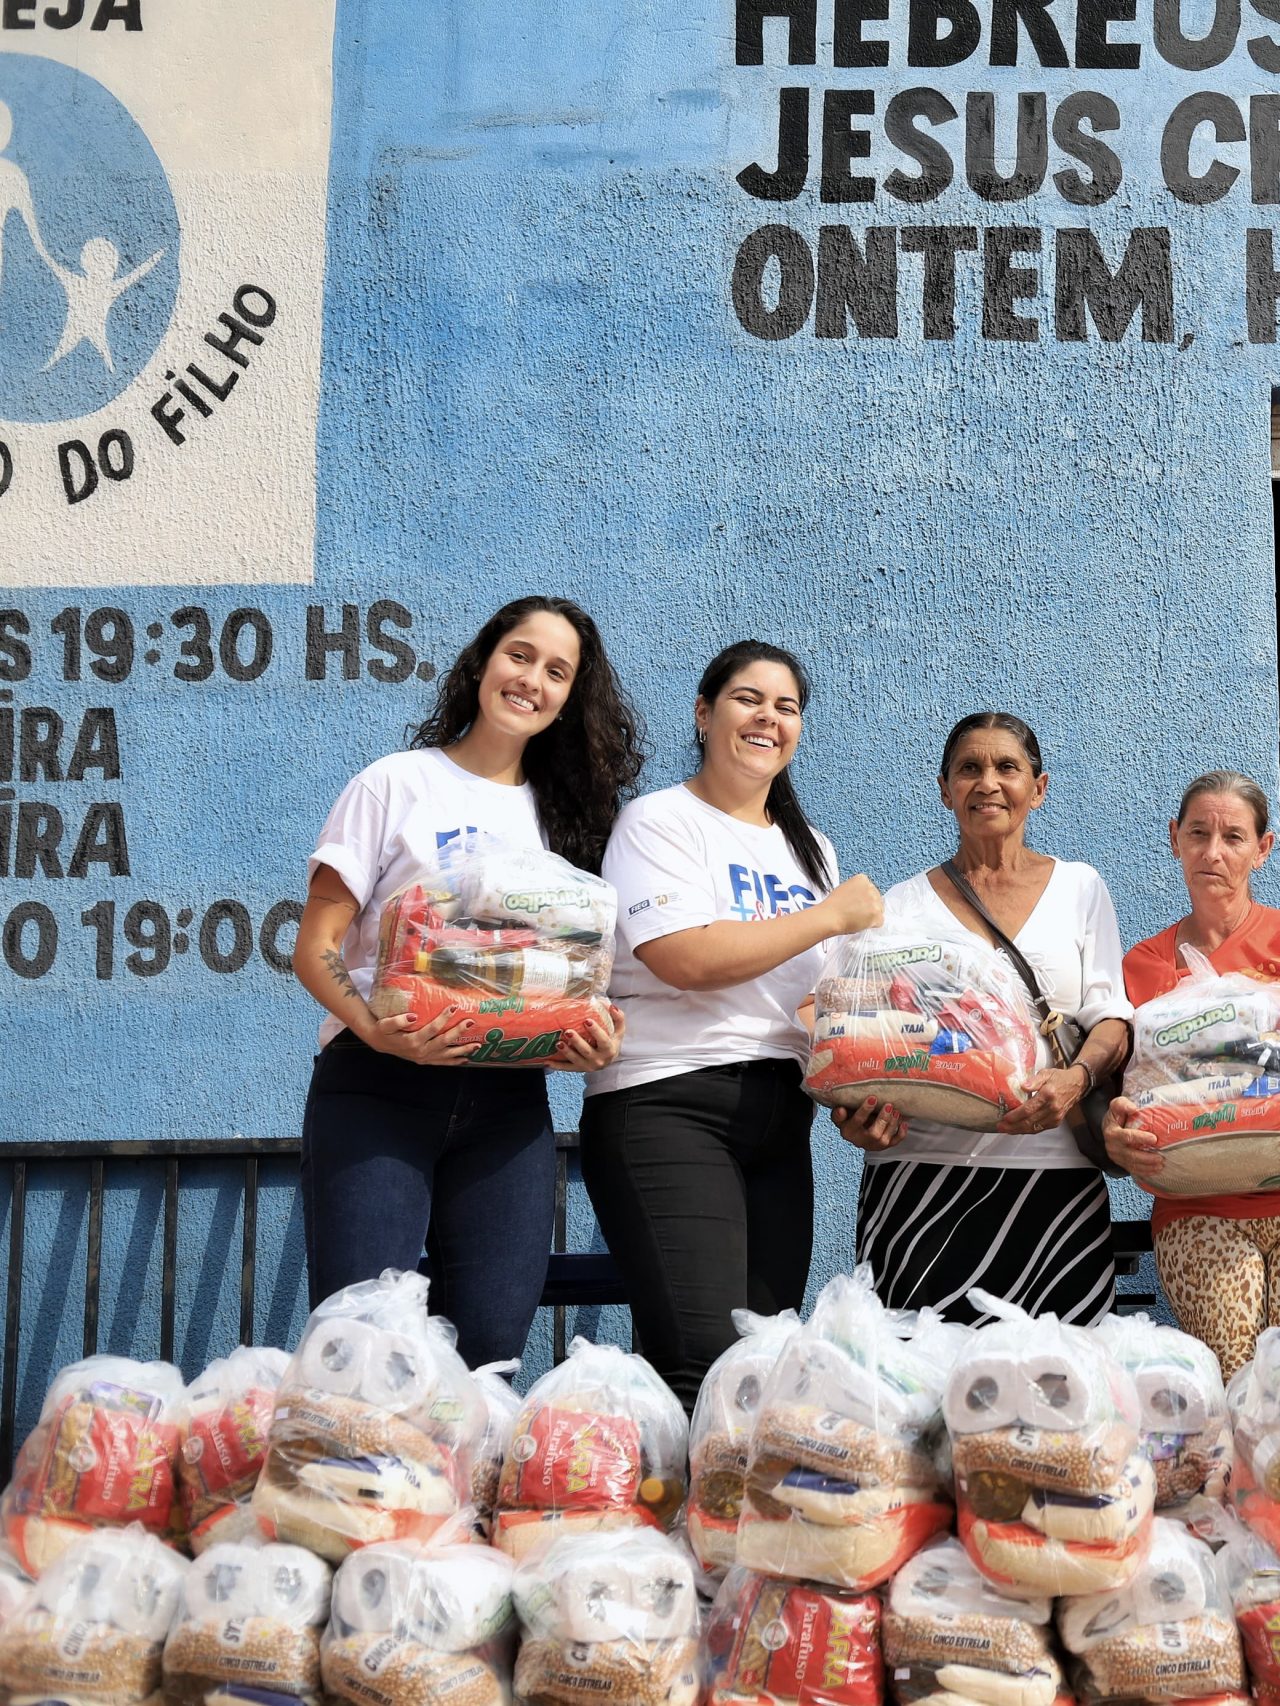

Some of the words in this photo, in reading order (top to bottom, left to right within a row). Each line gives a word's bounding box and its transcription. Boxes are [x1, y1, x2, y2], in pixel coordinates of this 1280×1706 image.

[735, 87, 1123, 205] JESUS
[731, 223, 1195, 353] ONTEM,
[57, 429, 134, 504] DO
[50, 606, 273, 684] 19:30
[305, 599, 436, 684] HS.
[502, 888, 592, 914] Paradiso
[1155, 1003, 1237, 1047] Paradiso
[541, 1419, 569, 1487] Parafuso
[1010, 1457, 1034, 1471] CINCO
[1033, 1460, 1069, 1479] ESTRELAS
[794, 1602, 819, 1681] Parafuso
[932, 1633, 955, 1646] CINCO
[954, 1635, 991, 1650] ESTRELAS
[217, 1656, 241, 1669] CINCO
[241, 1659, 277, 1673] ESTRELAS
[557, 1673, 578, 1687] CINCO
[577, 1676, 612, 1691] ESTRELAS
[1155, 1663, 1177, 1676] CINCO
[1177, 1659, 1211, 1673] ESTRELAS
